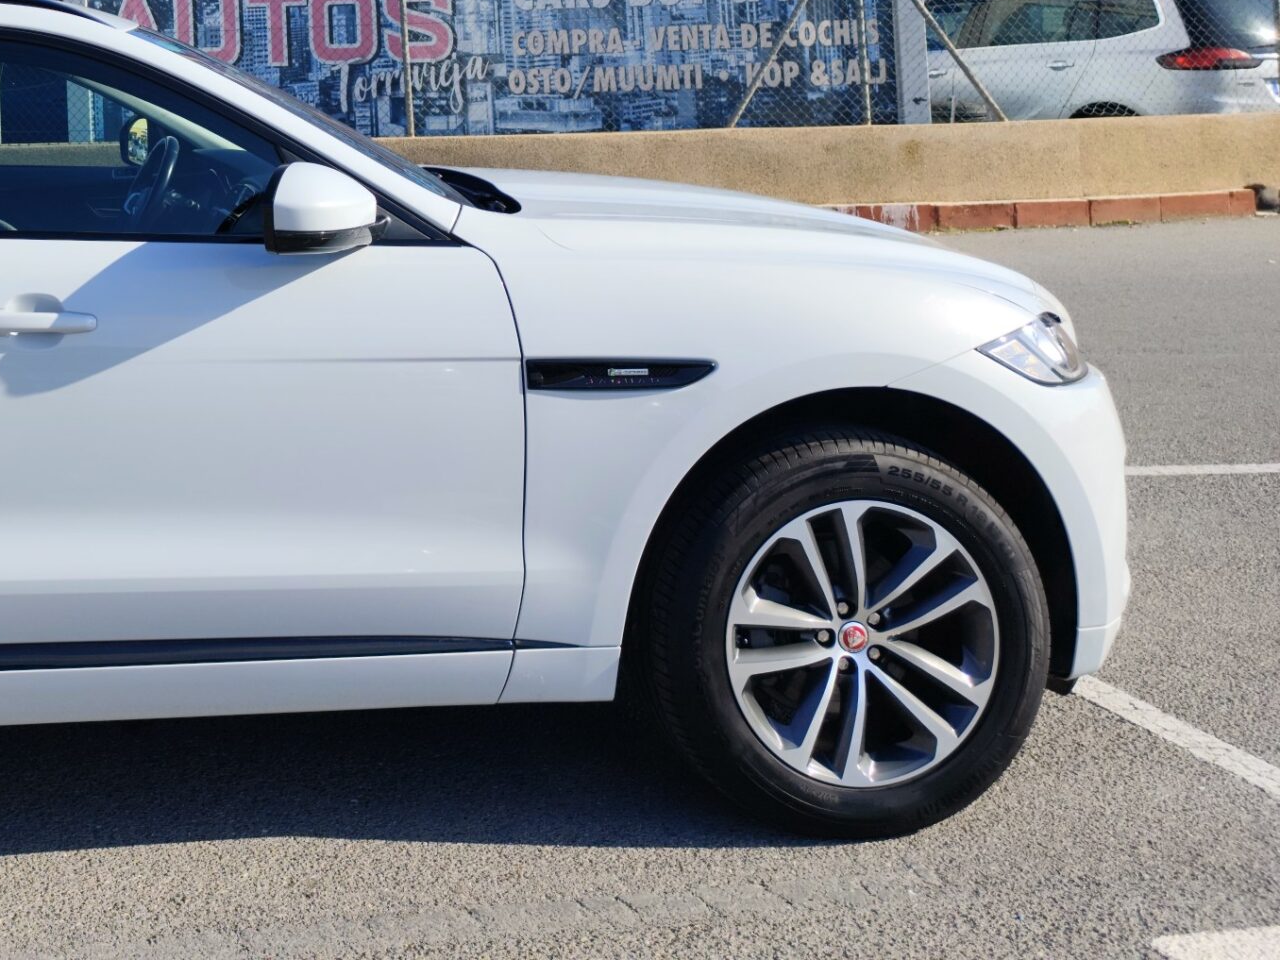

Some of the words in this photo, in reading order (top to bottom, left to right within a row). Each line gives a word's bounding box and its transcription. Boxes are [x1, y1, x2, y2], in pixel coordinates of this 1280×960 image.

[513, 27, 624, 56] COMPRA
[648, 22, 731, 52] VENTA
[740, 22, 773, 49] DE
[330, 52, 490, 114] Torrvieja
[508, 63, 704, 99] OSTO/MUUMTI
[888, 465, 953, 498] 255/55
